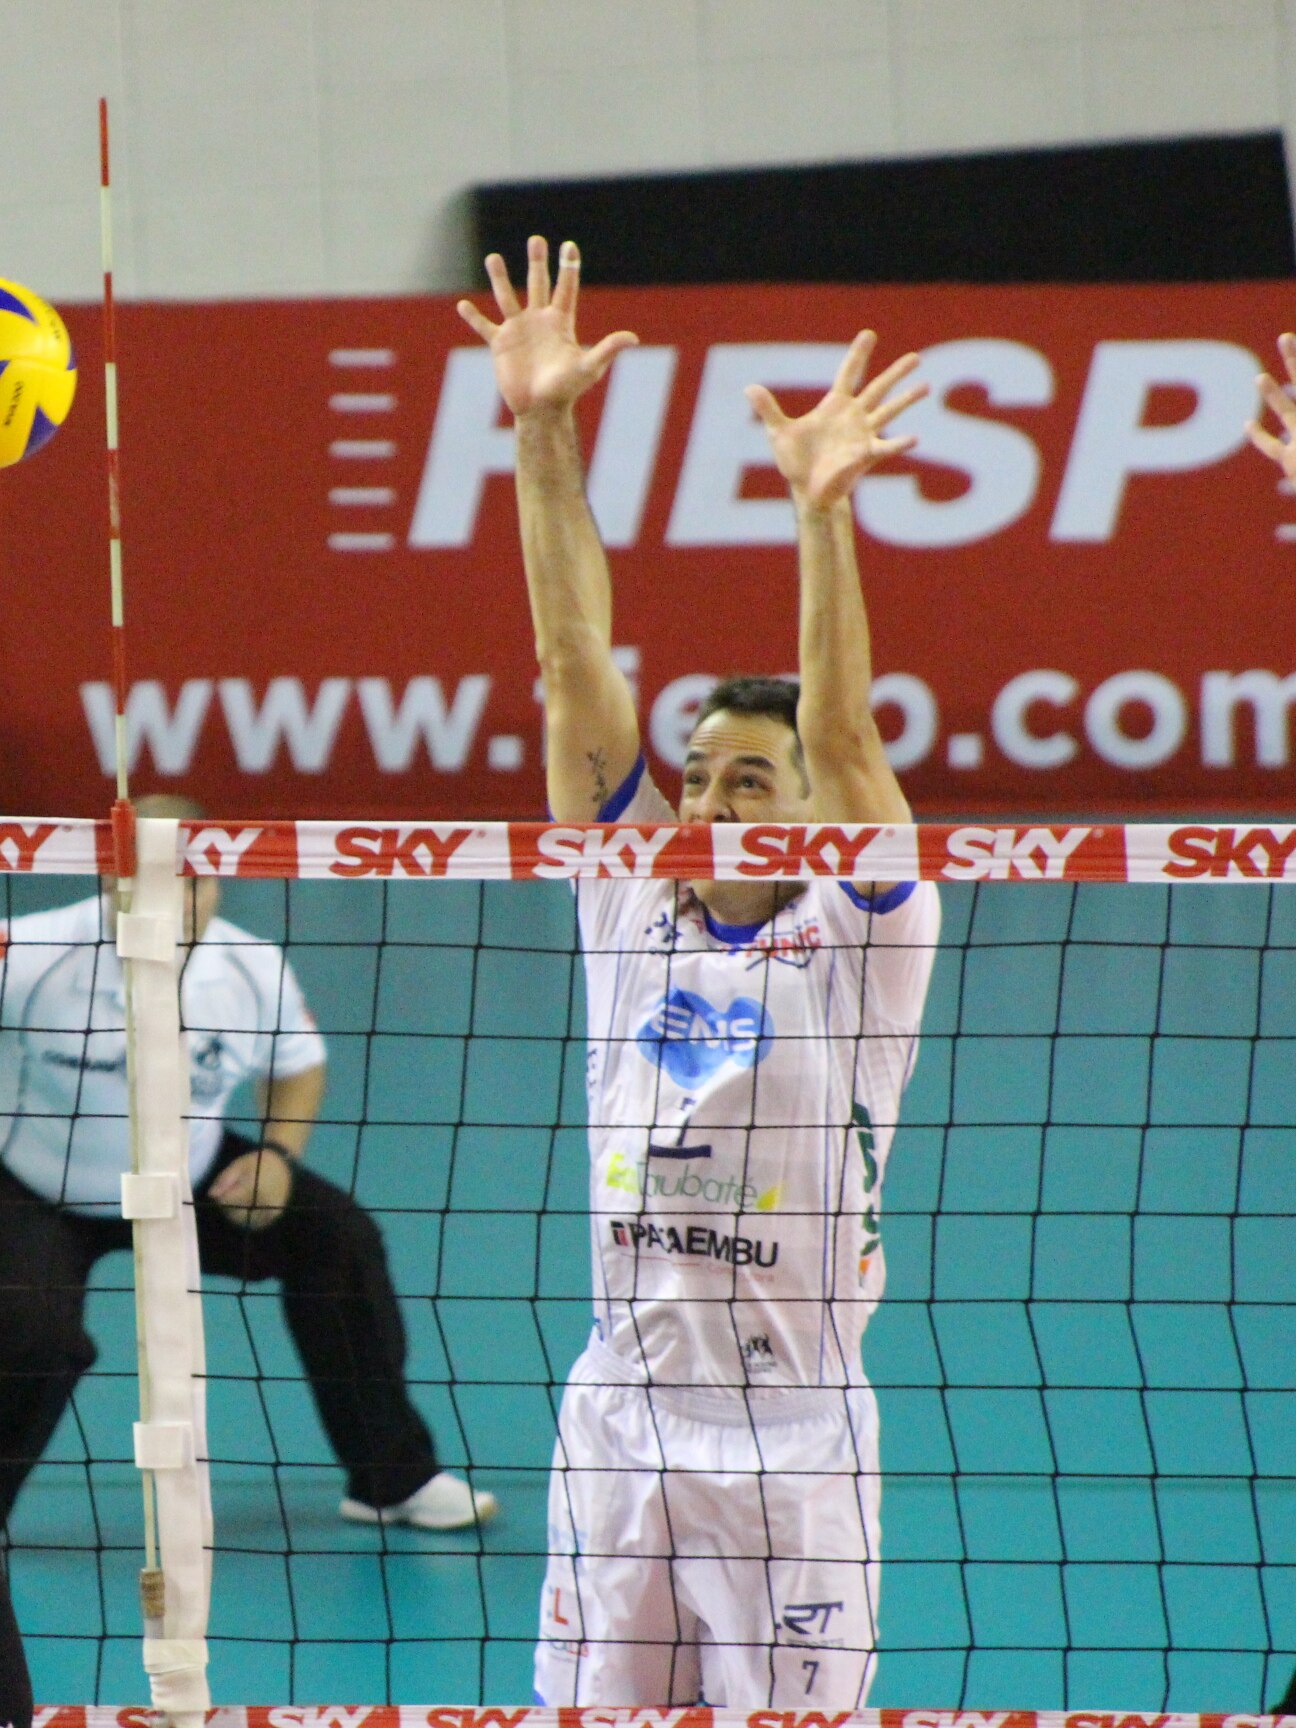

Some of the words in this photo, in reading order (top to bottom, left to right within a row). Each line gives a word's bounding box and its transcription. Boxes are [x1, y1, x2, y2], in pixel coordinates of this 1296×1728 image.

[407, 337, 1264, 550] FIESP
[175, 827, 264, 876] KY
[330, 827, 479, 877] SKY
[531, 828, 680, 878] SKY
[736, 826, 882, 877] SKY
[941, 827, 1092, 879] SKY
[1162, 827, 1296, 878] SKY
[628, 1221, 780, 1269] PAAEMBU
[802, 1660, 820, 1695] 7
